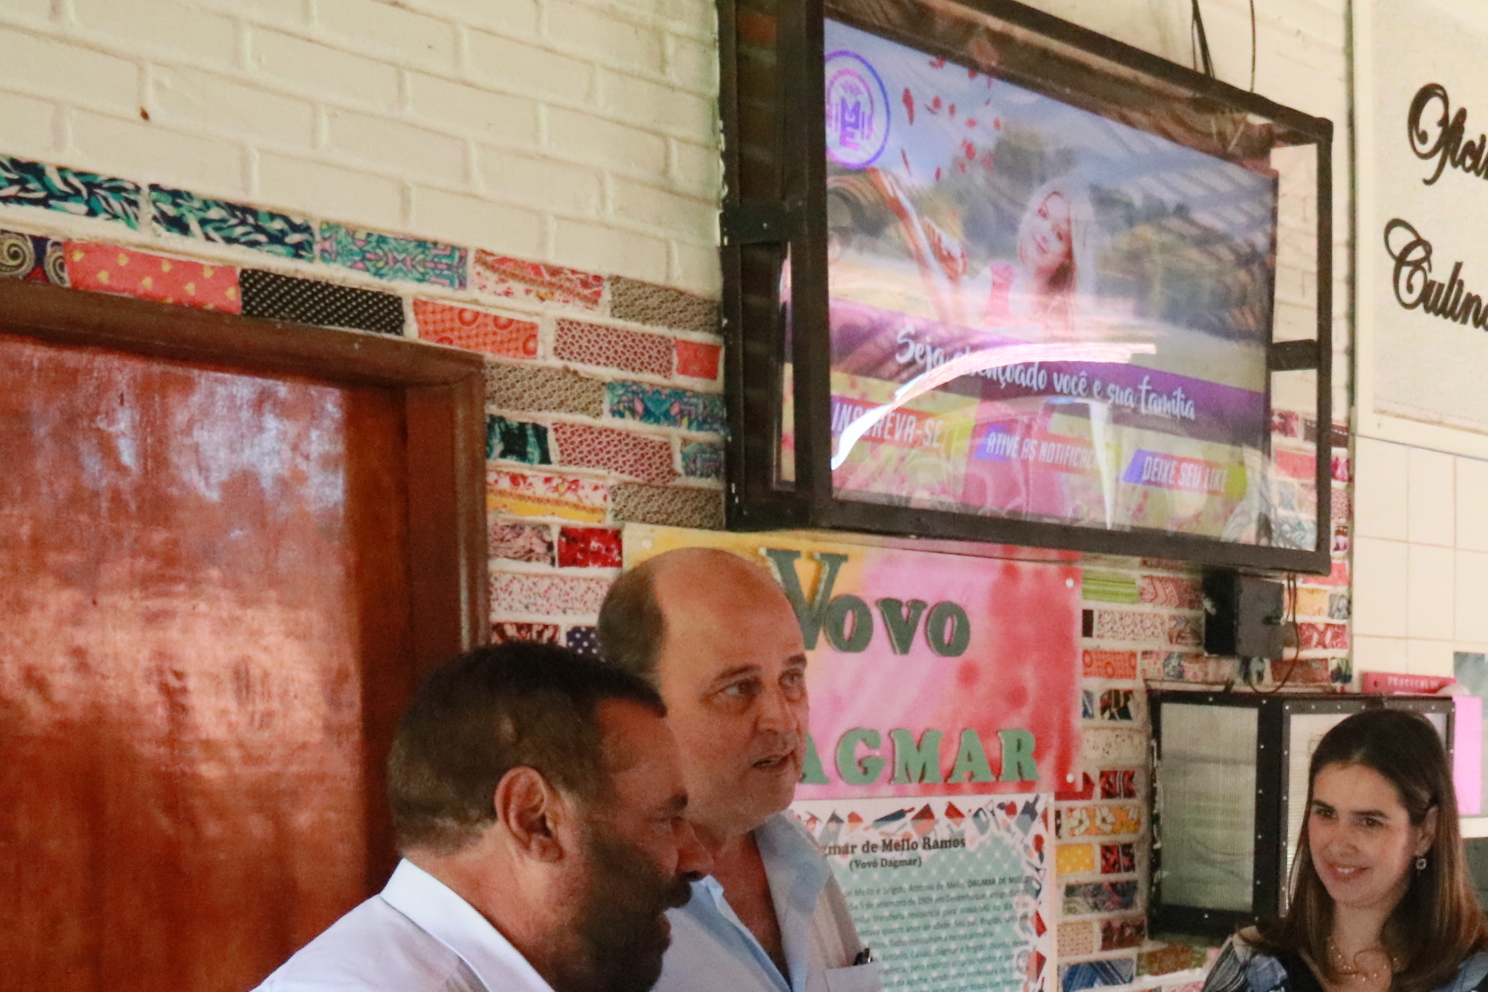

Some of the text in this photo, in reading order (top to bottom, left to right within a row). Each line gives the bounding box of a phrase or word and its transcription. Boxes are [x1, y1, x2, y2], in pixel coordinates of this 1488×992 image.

[895, 324, 947, 371] Seja
[1053, 371, 1088, 396] você
[1093, 382, 1104, 398] e
[1107, 385, 1136, 409] sua
[1138, 375, 1196, 421] família
[986, 432, 1019, 459] ATIVE
[1022, 437, 1037, 460] AS
[1142, 457, 1229, 491] DEIXE SEU LIKE
[799, 728, 1041, 785] AGMAR
[861, 841, 878, 853] de
[882, 838, 918, 852] Mello
[922, 836, 966, 850] Ramos
[849, 857, 922, 871] (Vovó Dagmar)
